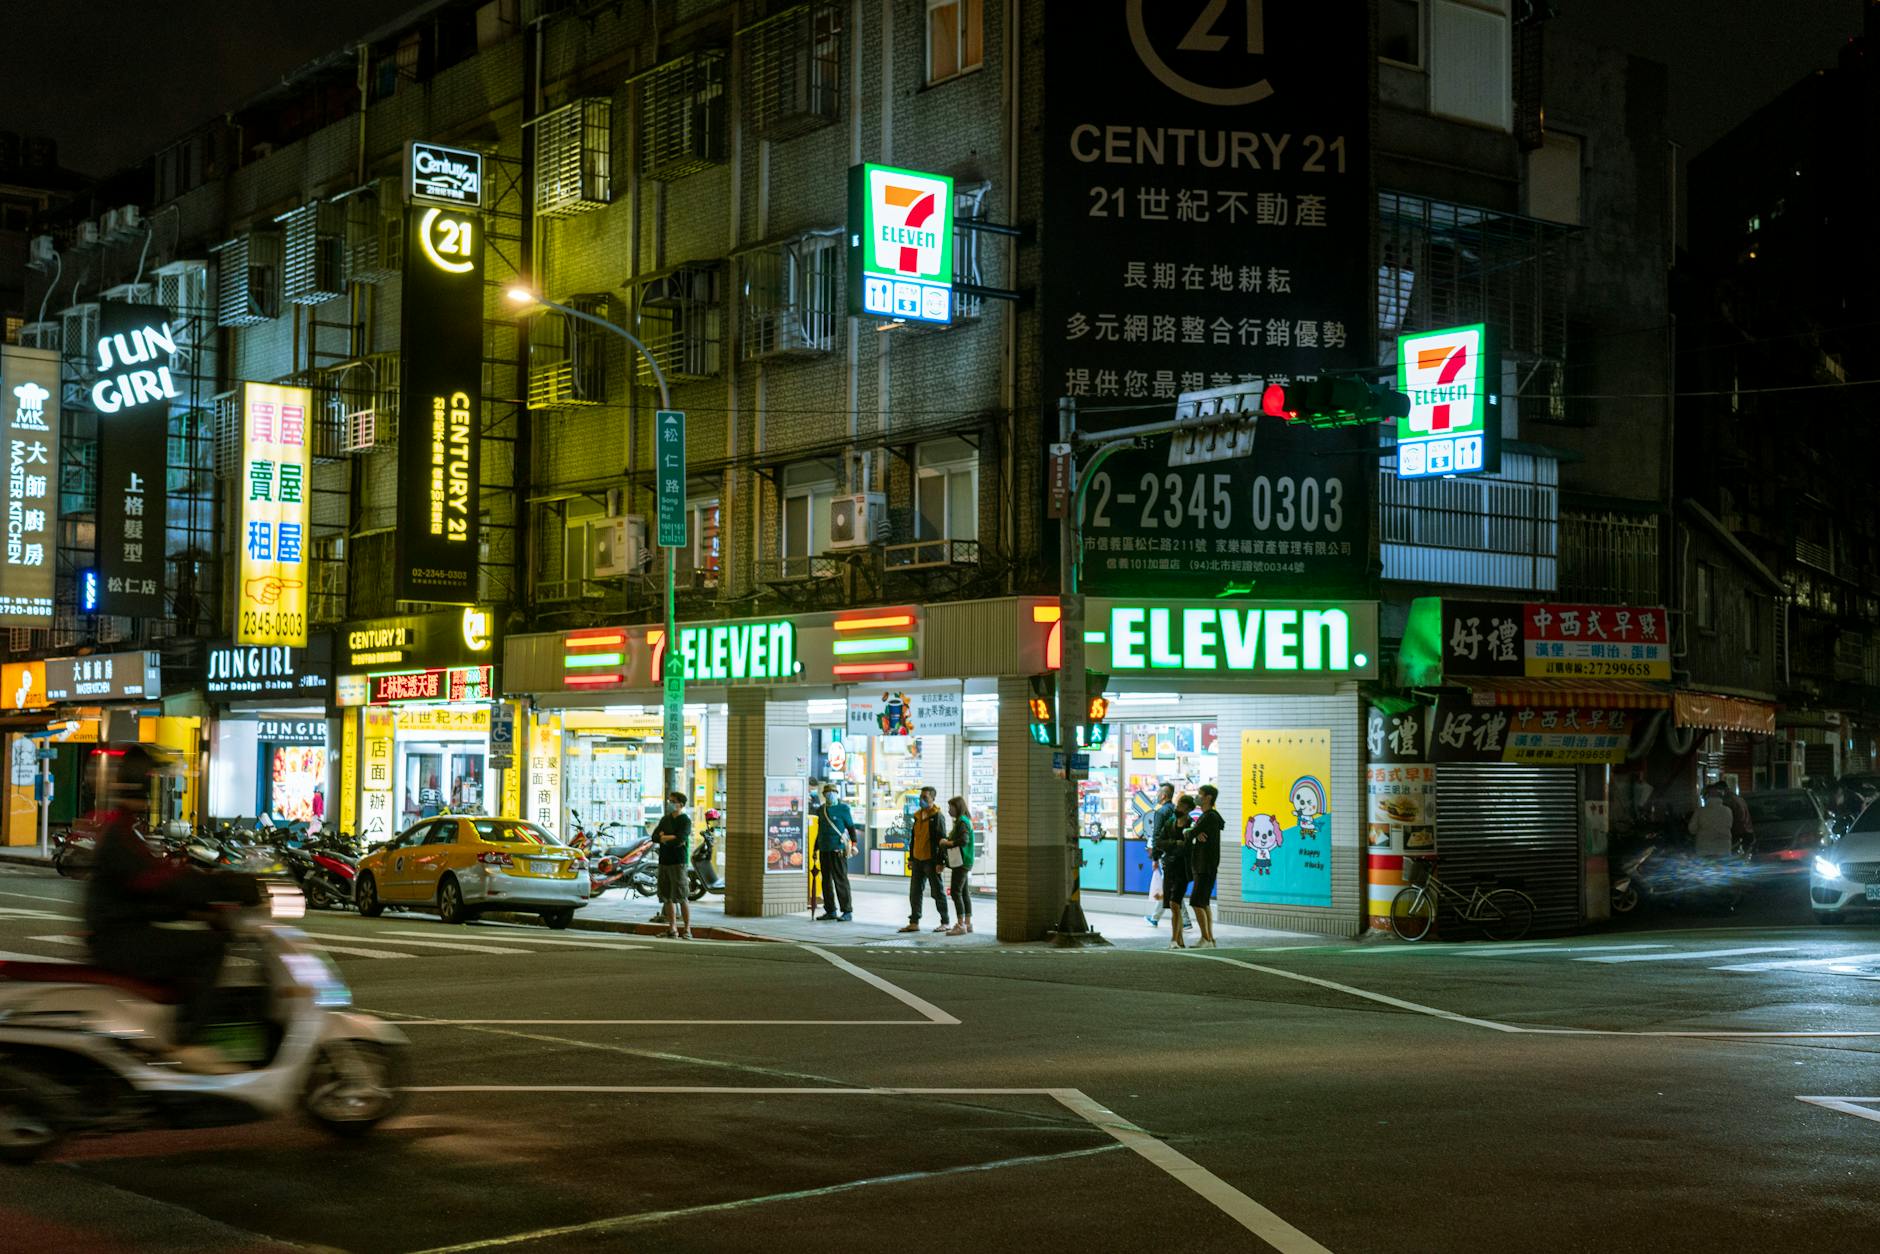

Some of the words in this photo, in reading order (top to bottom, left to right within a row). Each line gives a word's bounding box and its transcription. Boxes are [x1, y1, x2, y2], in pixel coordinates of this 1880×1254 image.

[1070, 123, 1291, 171] CENTURY
[1302, 134, 1347, 174] 21
[1089, 186, 1328, 228] 21世紀不動產
[1123, 261, 1292, 294] 長期在地耕耘
[97, 322, 178, 372] SUN
[1065, 312, 1347, 349] 多元網路整合行銷優勢
[91, 366, 182, 414] GIRL
[16, 408, 45, 425] MK
[9, 440, 26, 499] MASTER
[448, 390, 471, 514] CENTURY
[664, 427, 680, 494] 松仁路
[23, 441, 48, 567] 大師廚房
[1075, 471, 1232, 530] 2-2345
[1252, 475, 1344, 533] 0303
[8, 501, 23, 565] KITCHEN
[447, 518, 468, 542] 21
[108, 576, 157, 596] 松仁店
[243, 610, 303, 638] 2345-0303
[349, 629, 395, 650] CENTURY
[395, 627, 406, 646] 21
[1449, 616, 1520, 662] 好禮
[1532, 607, 1659, 642] 中西式早點
[209, 682, 229, 692] Hair
[230, 681, 263, 692] Design
[265, 680, 293, 690] Salon
[1438, 710, 1508, 752] 好禮
